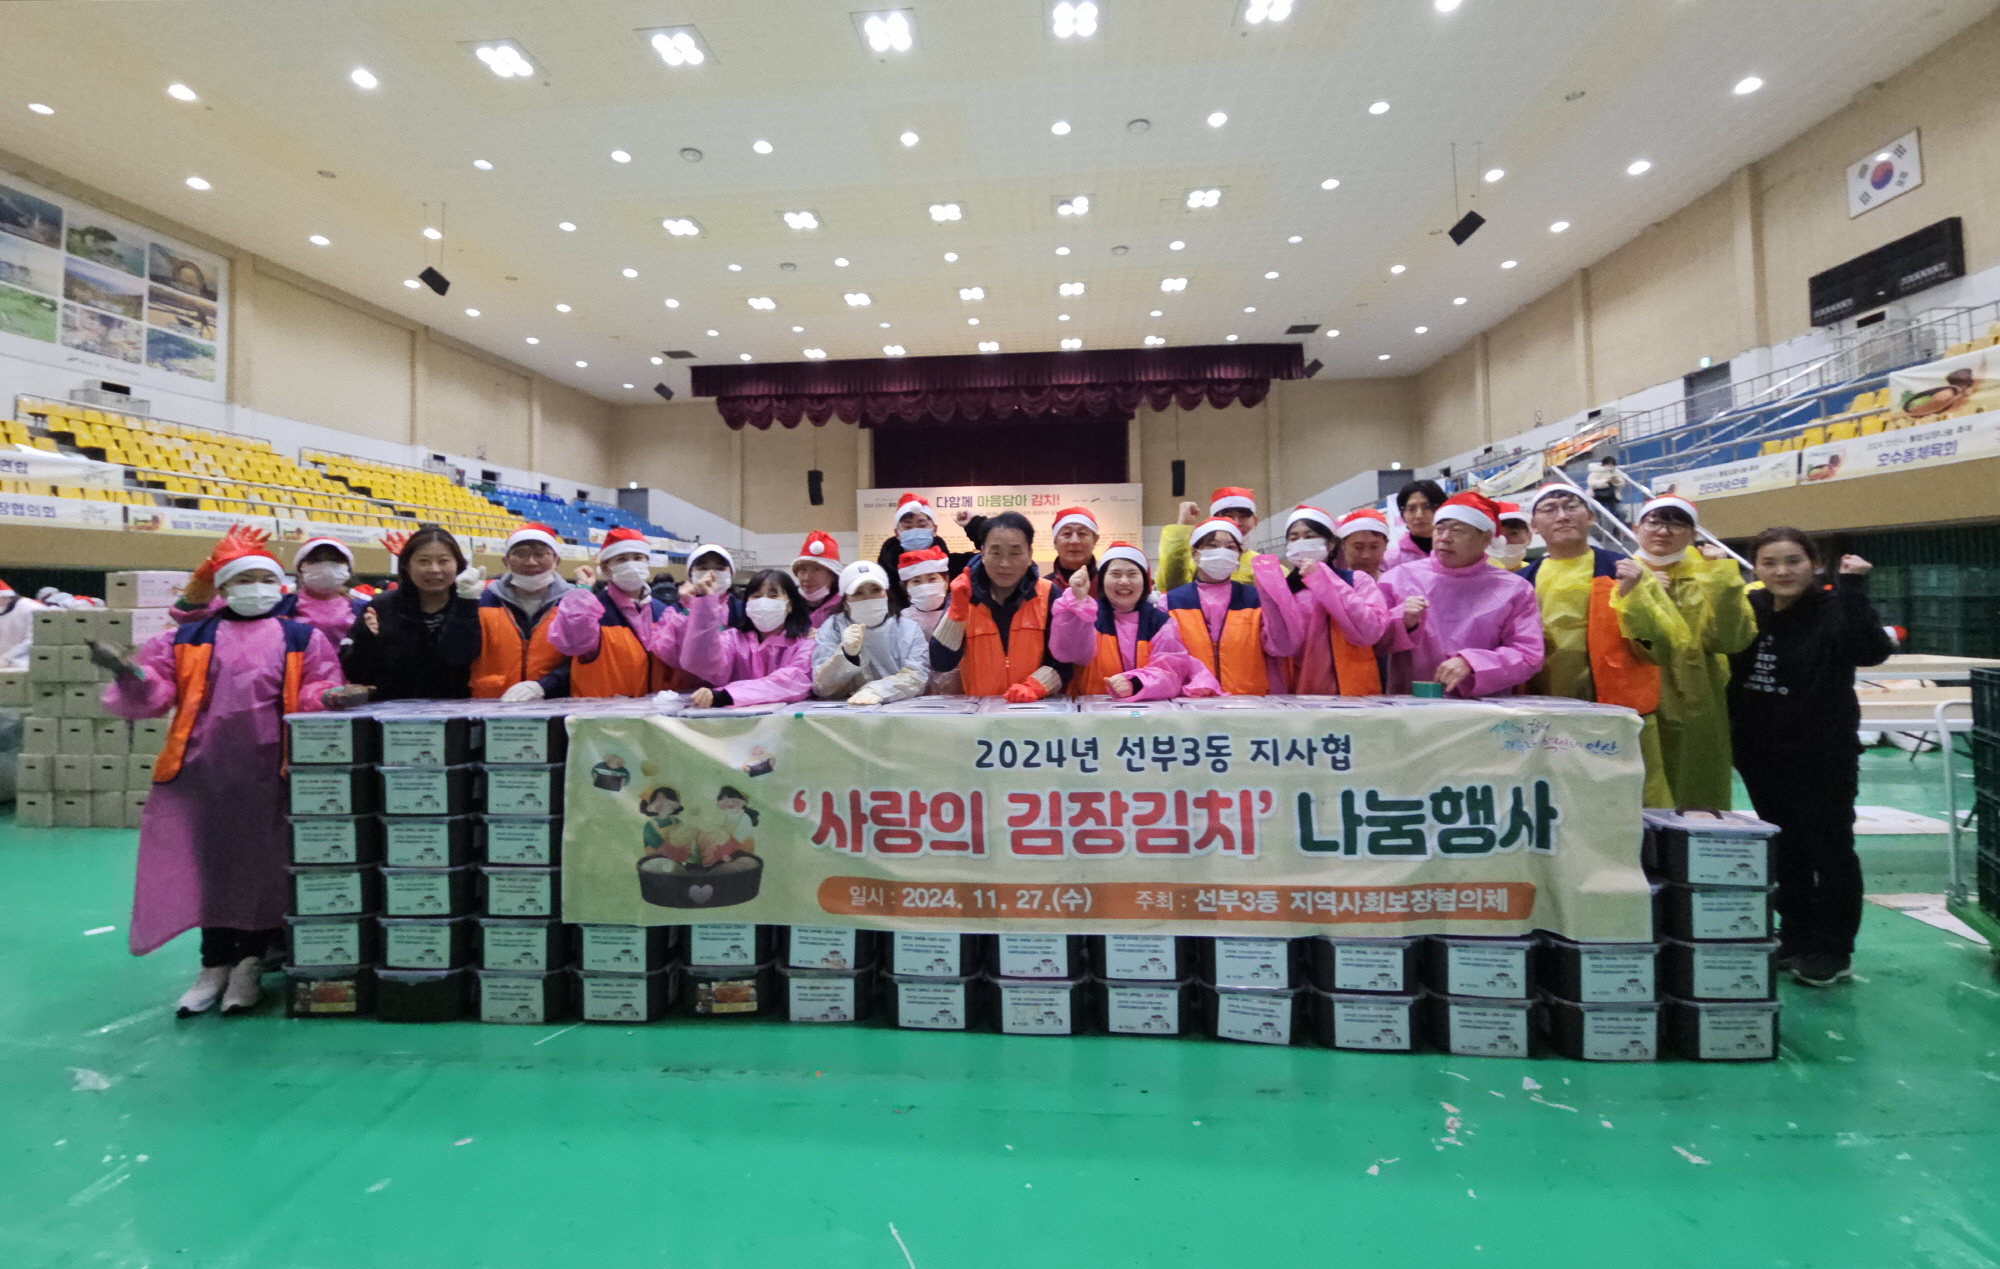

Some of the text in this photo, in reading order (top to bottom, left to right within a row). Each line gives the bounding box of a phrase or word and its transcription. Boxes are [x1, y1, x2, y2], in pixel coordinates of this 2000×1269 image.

[1877, 441, 1957, 467] 호수동체육회
[936, 496, 973, 508] 다함께
[977, 495, 1027, 507] 마음담아
[1031, 494, 1060, 506] 김치!
[975, 735, 1352, 773] 2024년 선부3동 지사협
[1297, 781, 1558, 855] 나눔행사
[849, 886, 885, 907] 일시
[902, 888, 962, 909] 2024.
[974, 888, 1007, 910] 11.
[1015, 887, 1092, 912] 27.(수)
[1135, 890, 1174, 910] 주최
[1194, 889, 1280, 912] 선부3동
[1290, 887, 1508, 914] 지역사회보장협의체
